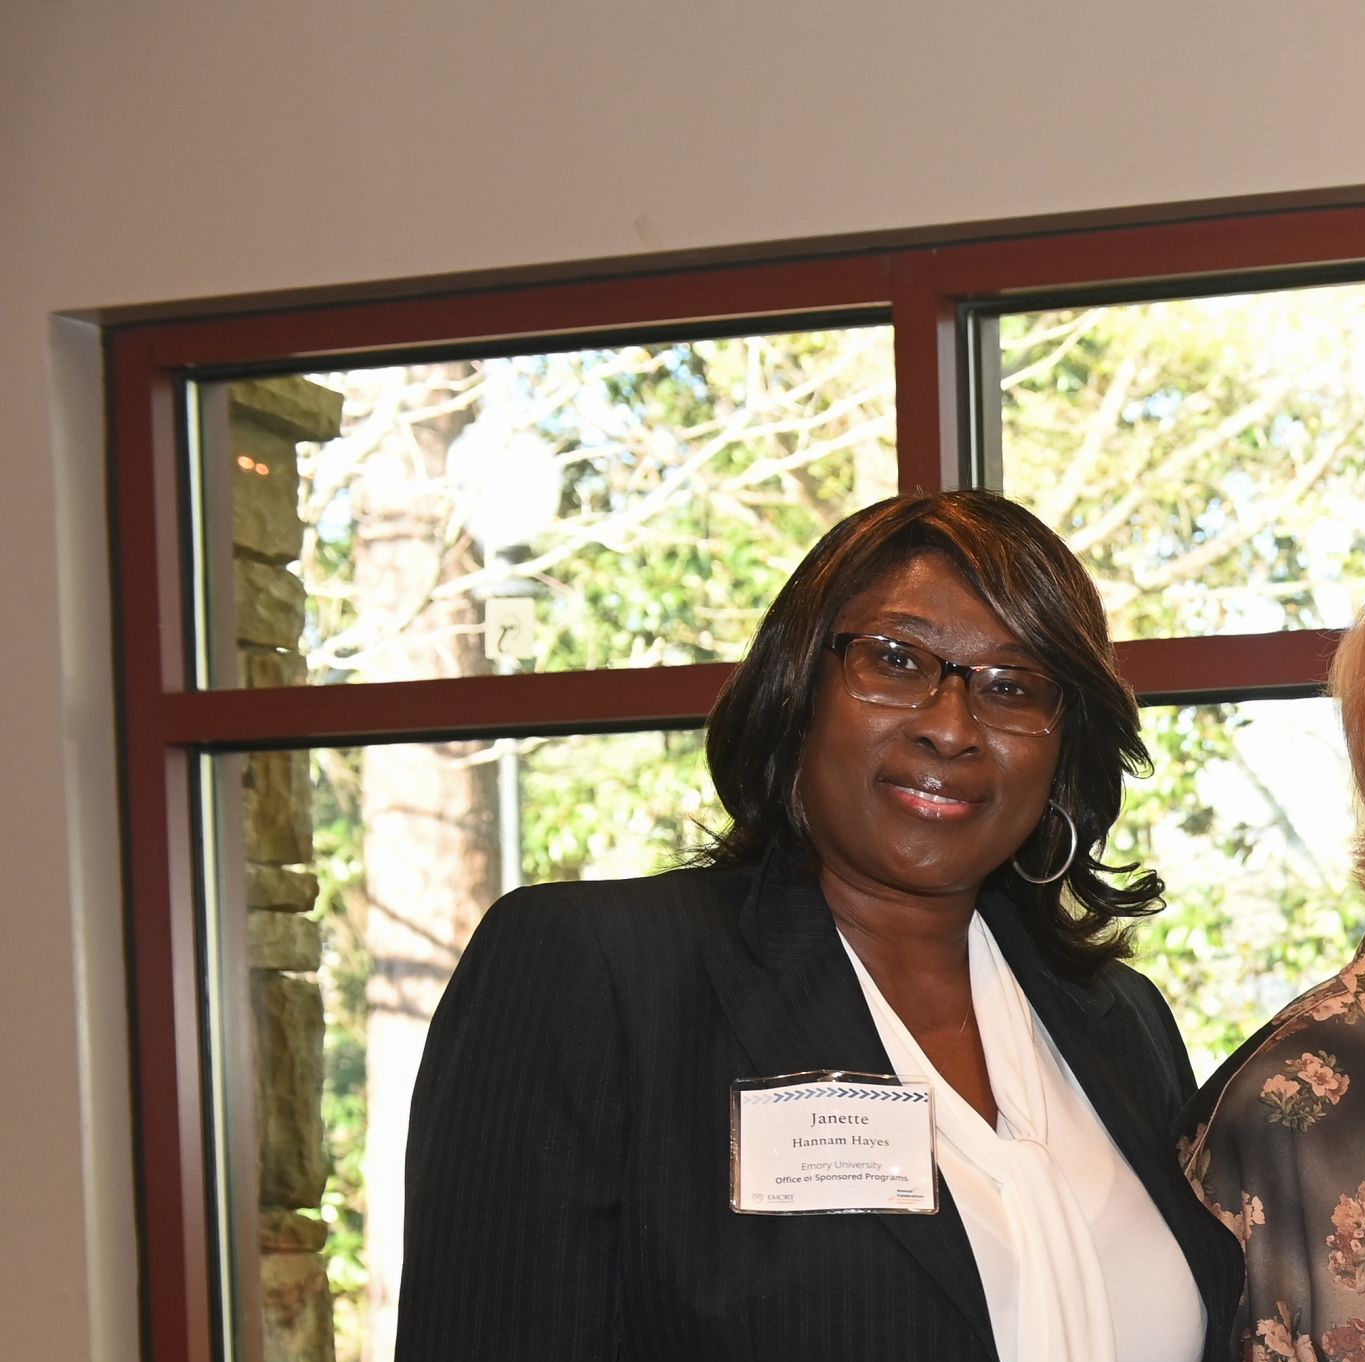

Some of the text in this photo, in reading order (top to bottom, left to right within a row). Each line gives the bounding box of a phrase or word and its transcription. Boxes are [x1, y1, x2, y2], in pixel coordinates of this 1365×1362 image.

[811, 1112, 869, 1127] Janette
[792, 1135, 890, 1148] Hannam Hayes
[801, 1161, 882, 1171] Emory University
[775, 1176, 801, 1184] Office
[815, 1173, 862, 1182] Sponsored
[865, 1173, 908, 1182] Programs
